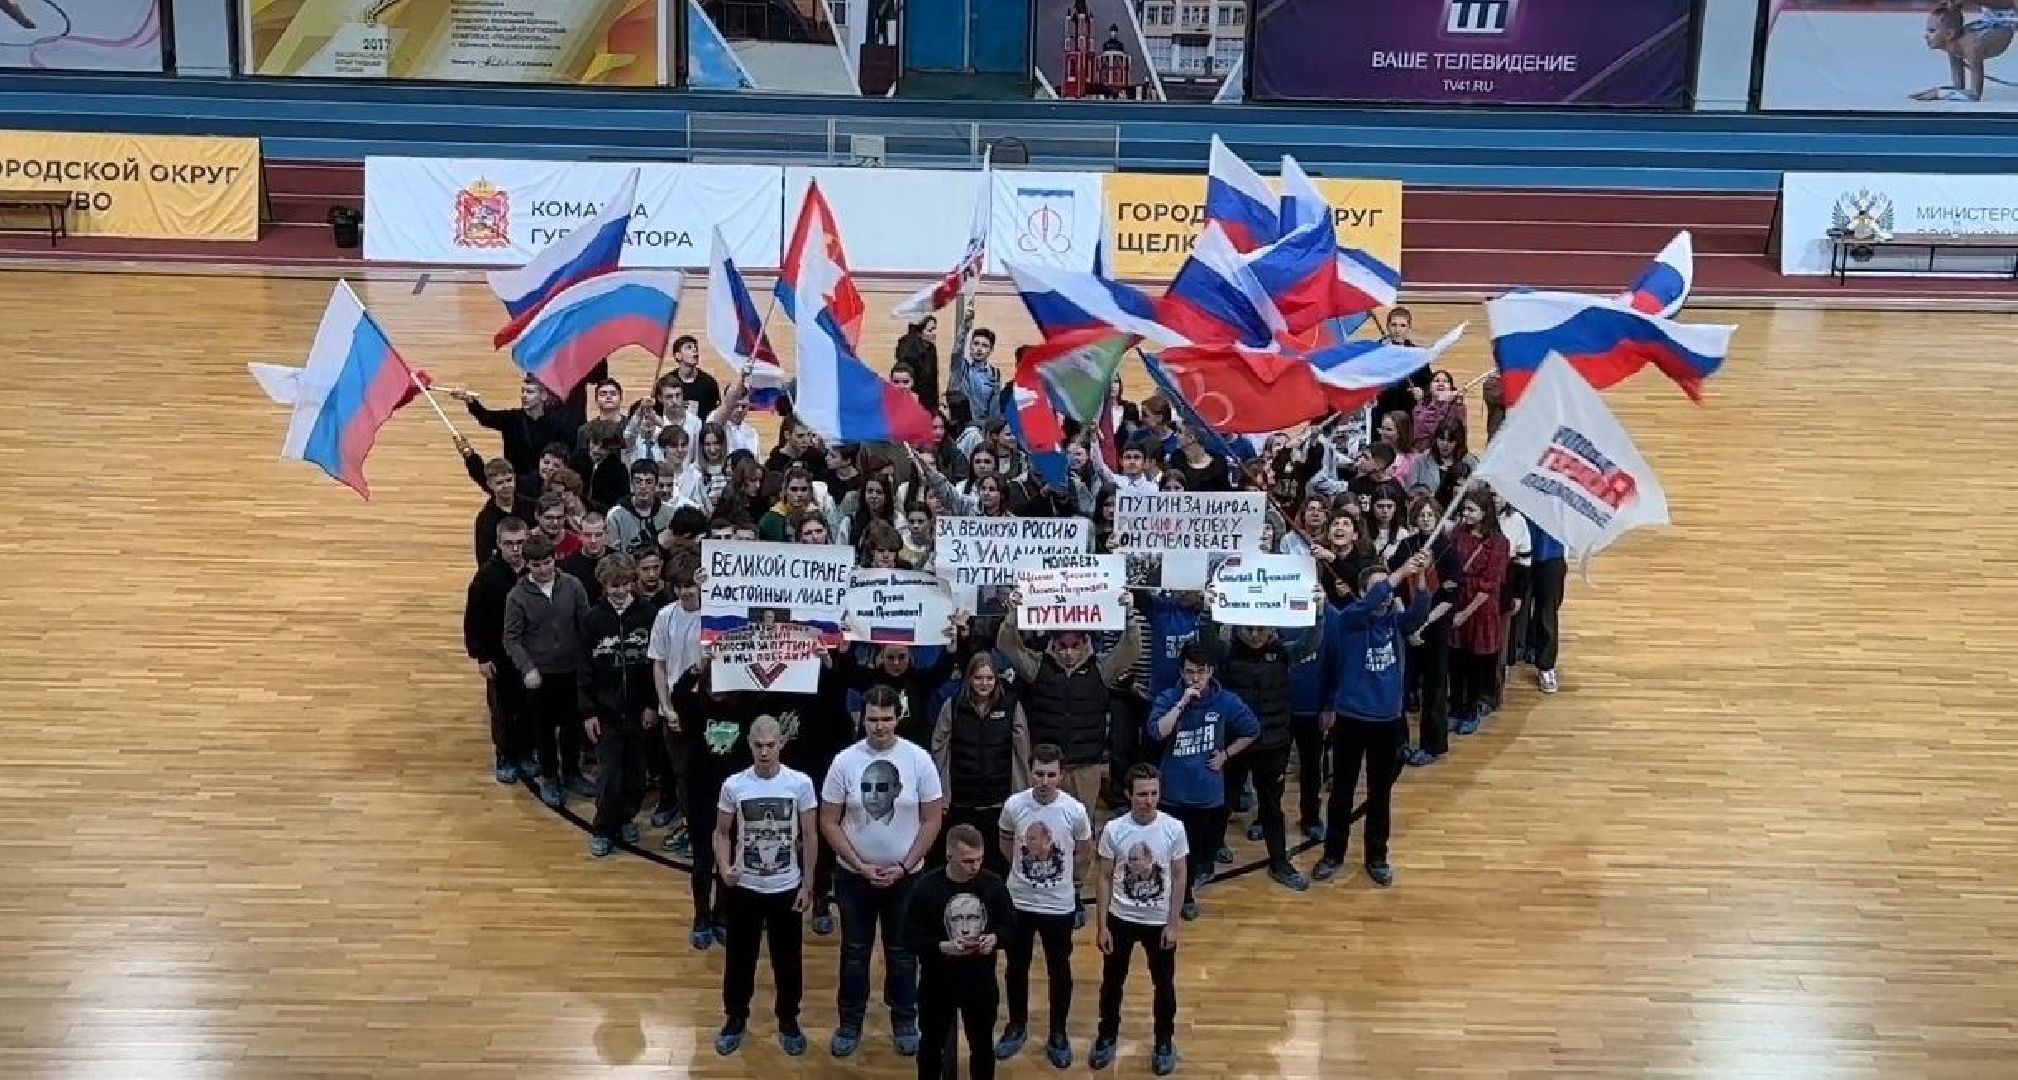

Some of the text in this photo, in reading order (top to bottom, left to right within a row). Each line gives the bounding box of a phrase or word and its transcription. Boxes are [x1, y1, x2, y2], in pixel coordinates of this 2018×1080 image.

[362, 38, 392, 51] 2017
[1371, 51, 1577, 73] ВАШЕ ТЕЛЕВИДЕНИЕ
[1442, 78, 1494, 92] TV41.RU
[0, 157, 240, 185] РОДСКОЙ ОКРУГ
[531, 200, 649, 218] КОМАА
[1117, 202, 1384, 228] ГОРОД РУГ
[531, 228, 694, 247] ГУБАТОРА
[1117, 232, 1198, 255] ЩЕЛК
[1118, 495, 1181, 513] ПУТИН
[1184, 495, 1201, 513] ЗА
[937, 518, 1078, 540] ЗА ВЕЛИКУЮ РОССИЮ
[1175, 517, 1183, 532] К
[1187, 516, 1243, 533] УСПЕХУ
[1120, 532, 1142, 548] ОН
[1146, 533, 1191, 549] СМЕЛО
[949, 539, 969, 563] ЗА
[711, 551, 847, 583] ВЕЛИКОЙ СТРАНЕ
[956, 566, 1015, 585] ПУТИН
[796, 587, 846, 606] ЛИДЕР
[1027, 604, 1102, 625] ПУТИНА
